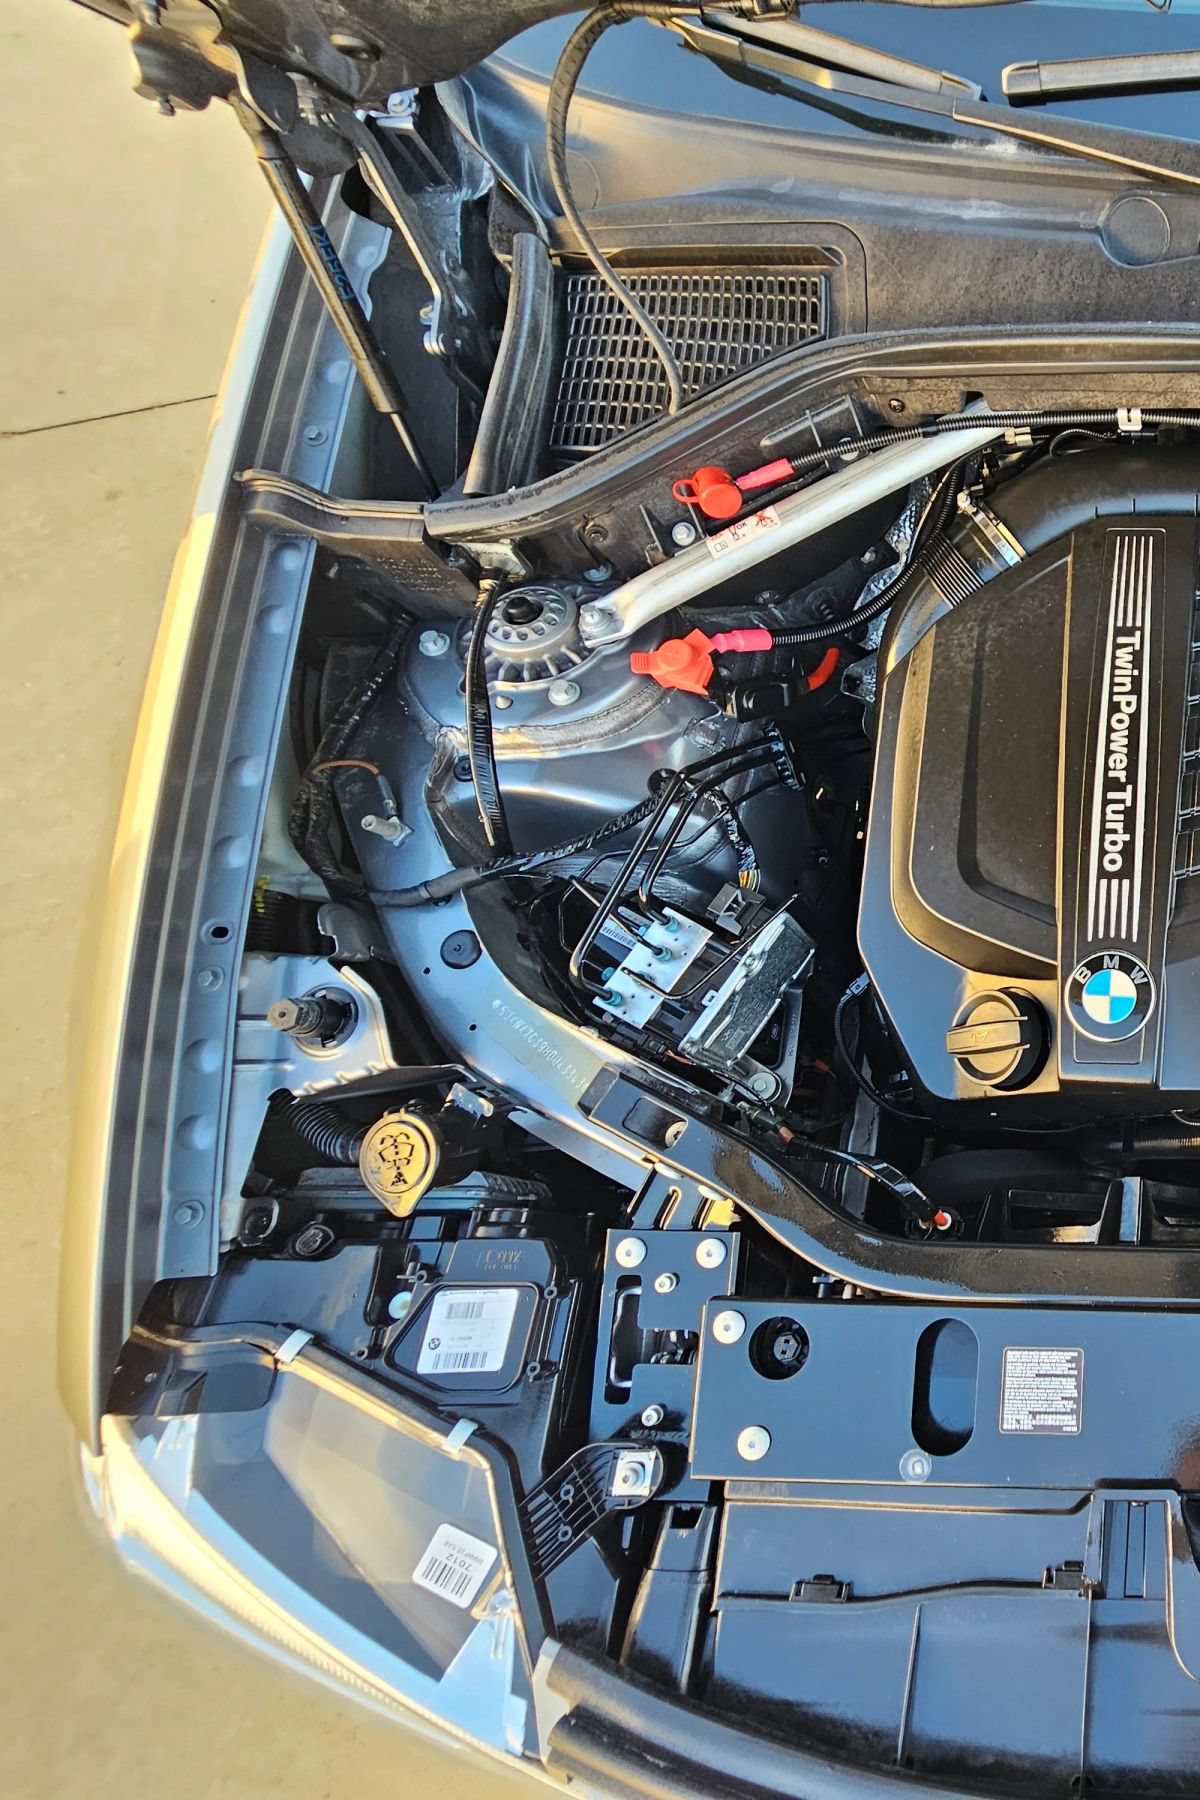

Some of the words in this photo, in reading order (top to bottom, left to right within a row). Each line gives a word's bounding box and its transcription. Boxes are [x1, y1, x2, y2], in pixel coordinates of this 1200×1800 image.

[1107, 630, 1141, 782] TwinPower
[1102, 784, 1133, 872] Turbo
[1074, 955, 1148, 985] BMW
[446, 1553, 472, 1571] 7012
